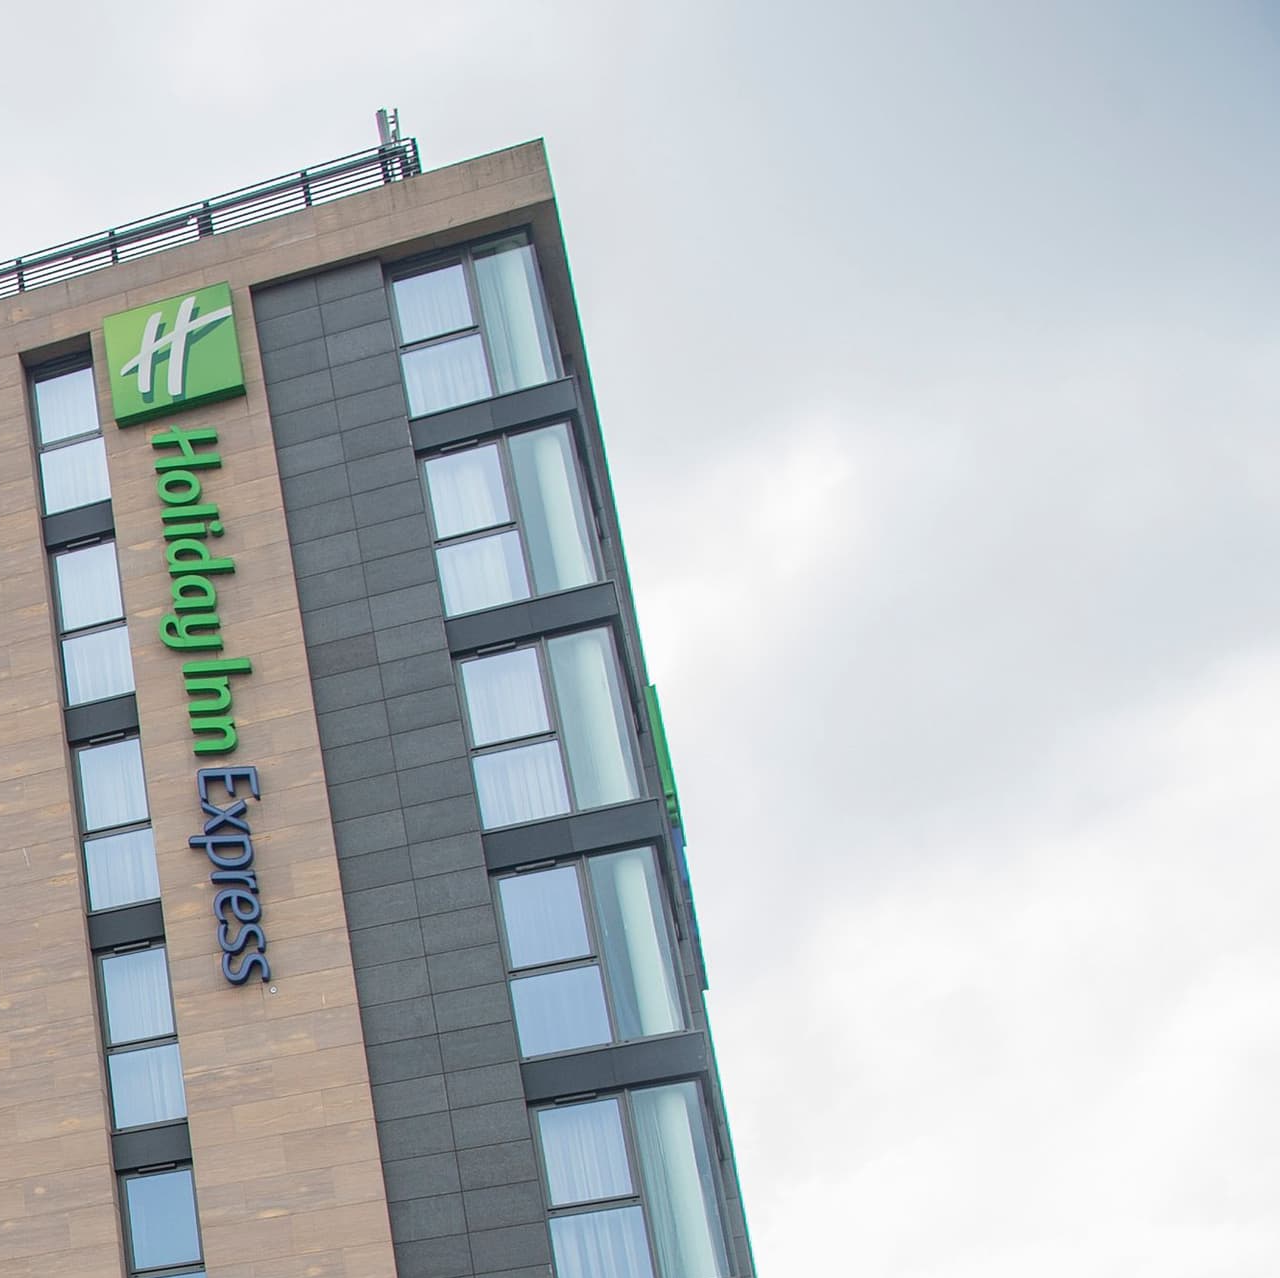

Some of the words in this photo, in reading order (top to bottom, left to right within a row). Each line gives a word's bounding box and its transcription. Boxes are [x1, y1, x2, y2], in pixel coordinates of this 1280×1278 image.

[151, 424, 236, 651] Holiday
[182, 656, 253, 757] Inn
[188, 766, 271, 985] Express
